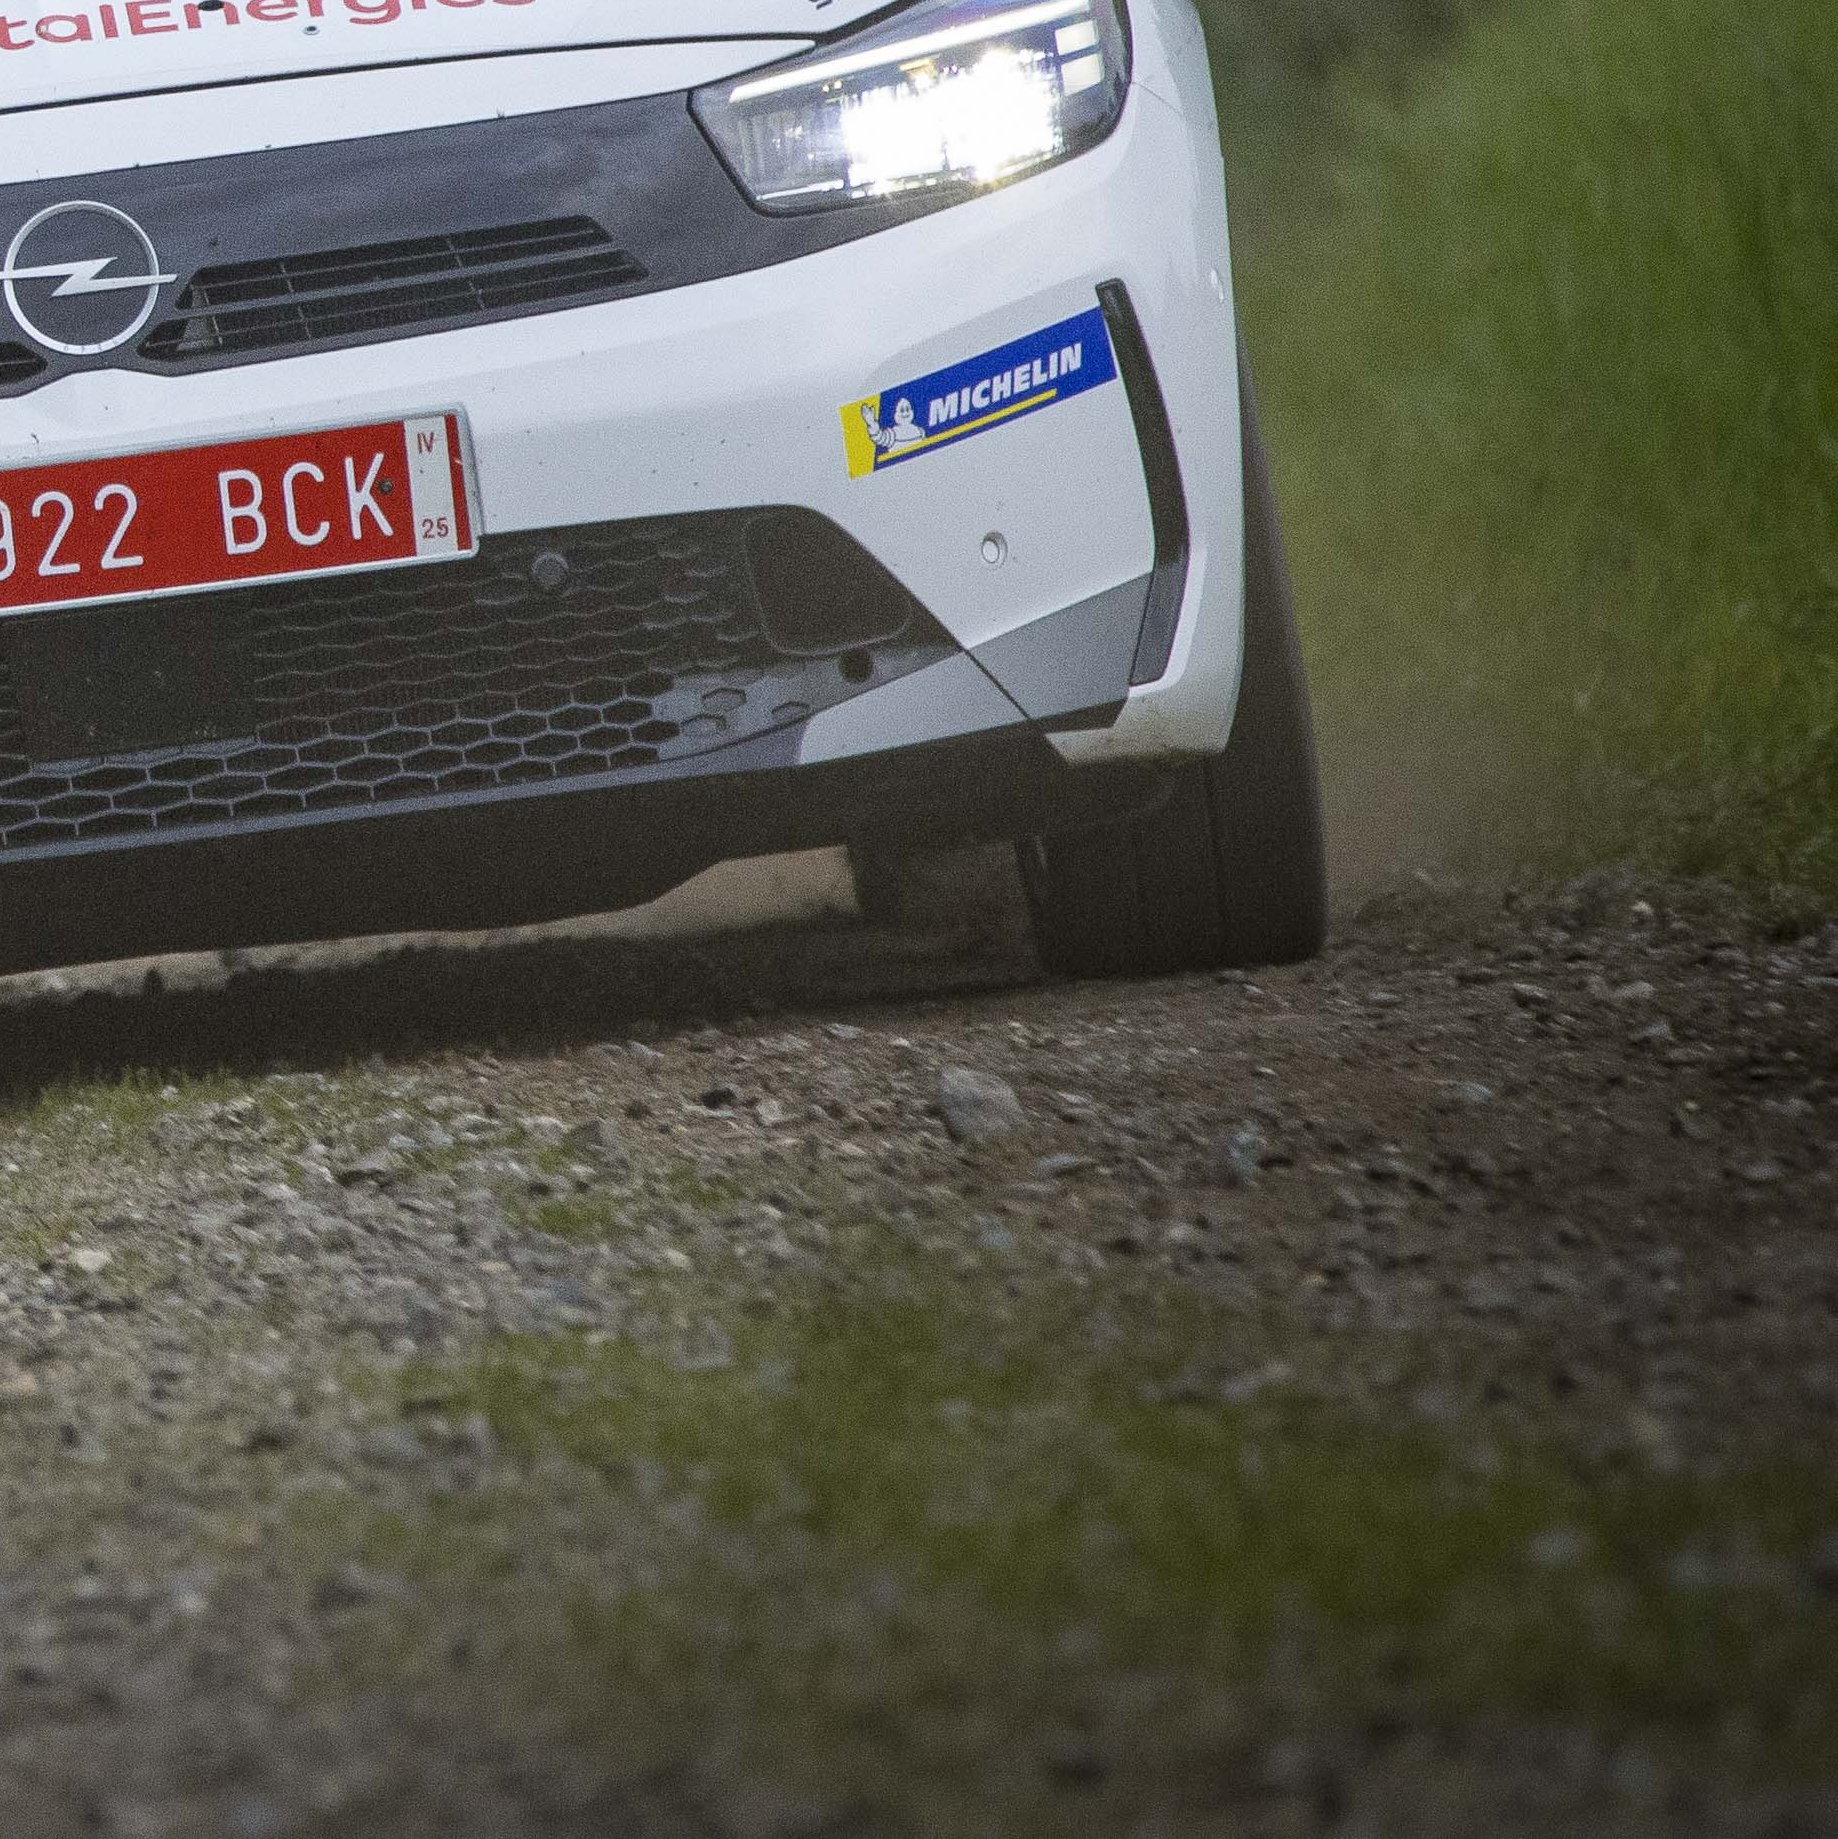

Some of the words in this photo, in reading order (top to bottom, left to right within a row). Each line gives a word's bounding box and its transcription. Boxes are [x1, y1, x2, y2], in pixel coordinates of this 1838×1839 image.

[928, 343, 1083, 427] MICHELIN
[416, 431, 436, 456] IV
[218, 452, 395, 556] BCK
[421, 516, 450, 541] 25
